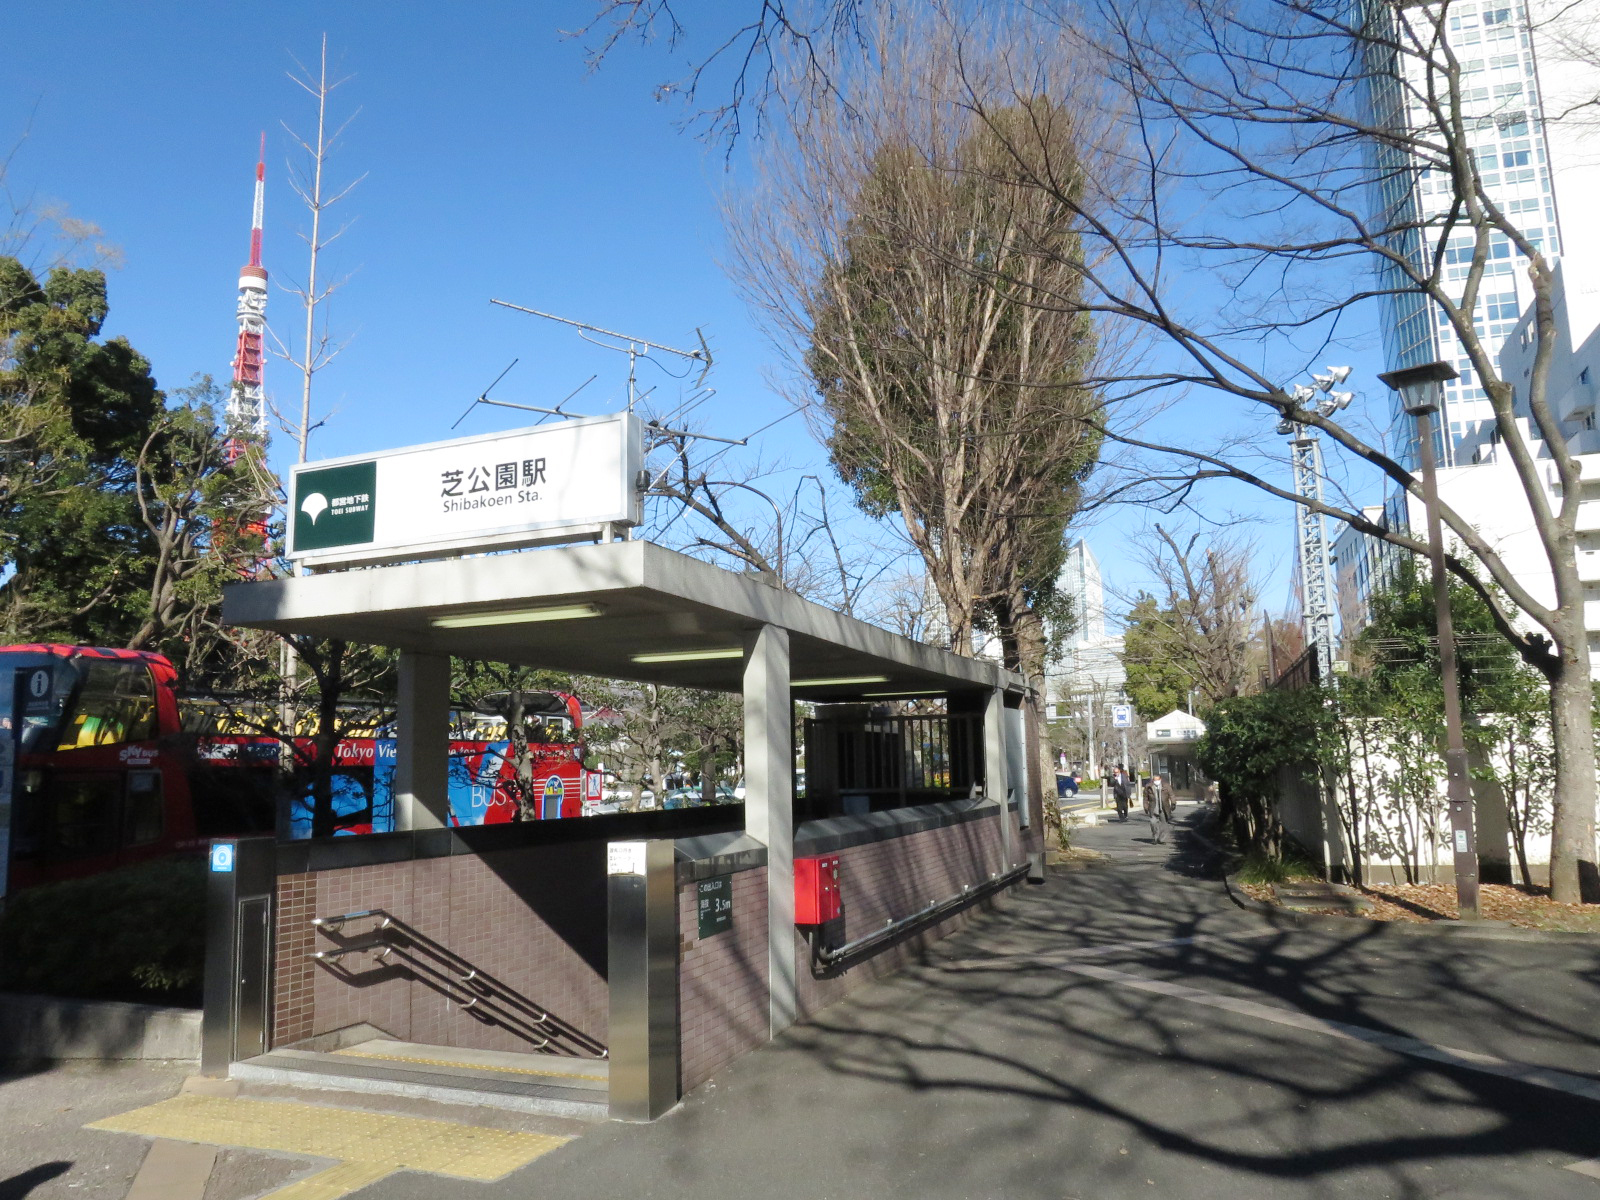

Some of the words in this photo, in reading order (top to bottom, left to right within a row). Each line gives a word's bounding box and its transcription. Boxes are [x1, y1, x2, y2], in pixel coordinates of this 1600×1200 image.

[441, 457, 546, 498] 芝公園駅
[331, 493, 369, 507] 都営地下鉄
[331, 507, 344, 516] TOEI
[345, 504, 369, 514] SUBWAY
[443, 495, 512, 513] Shibakoen
[517, 490, 543, 503] Sta.
[337, 742, 374, 763] Tokyo
[378, 743, 397, 758] Vie
[471, 783, 507, 808] BUS
[714, 897, 731, 912] 3.5m
